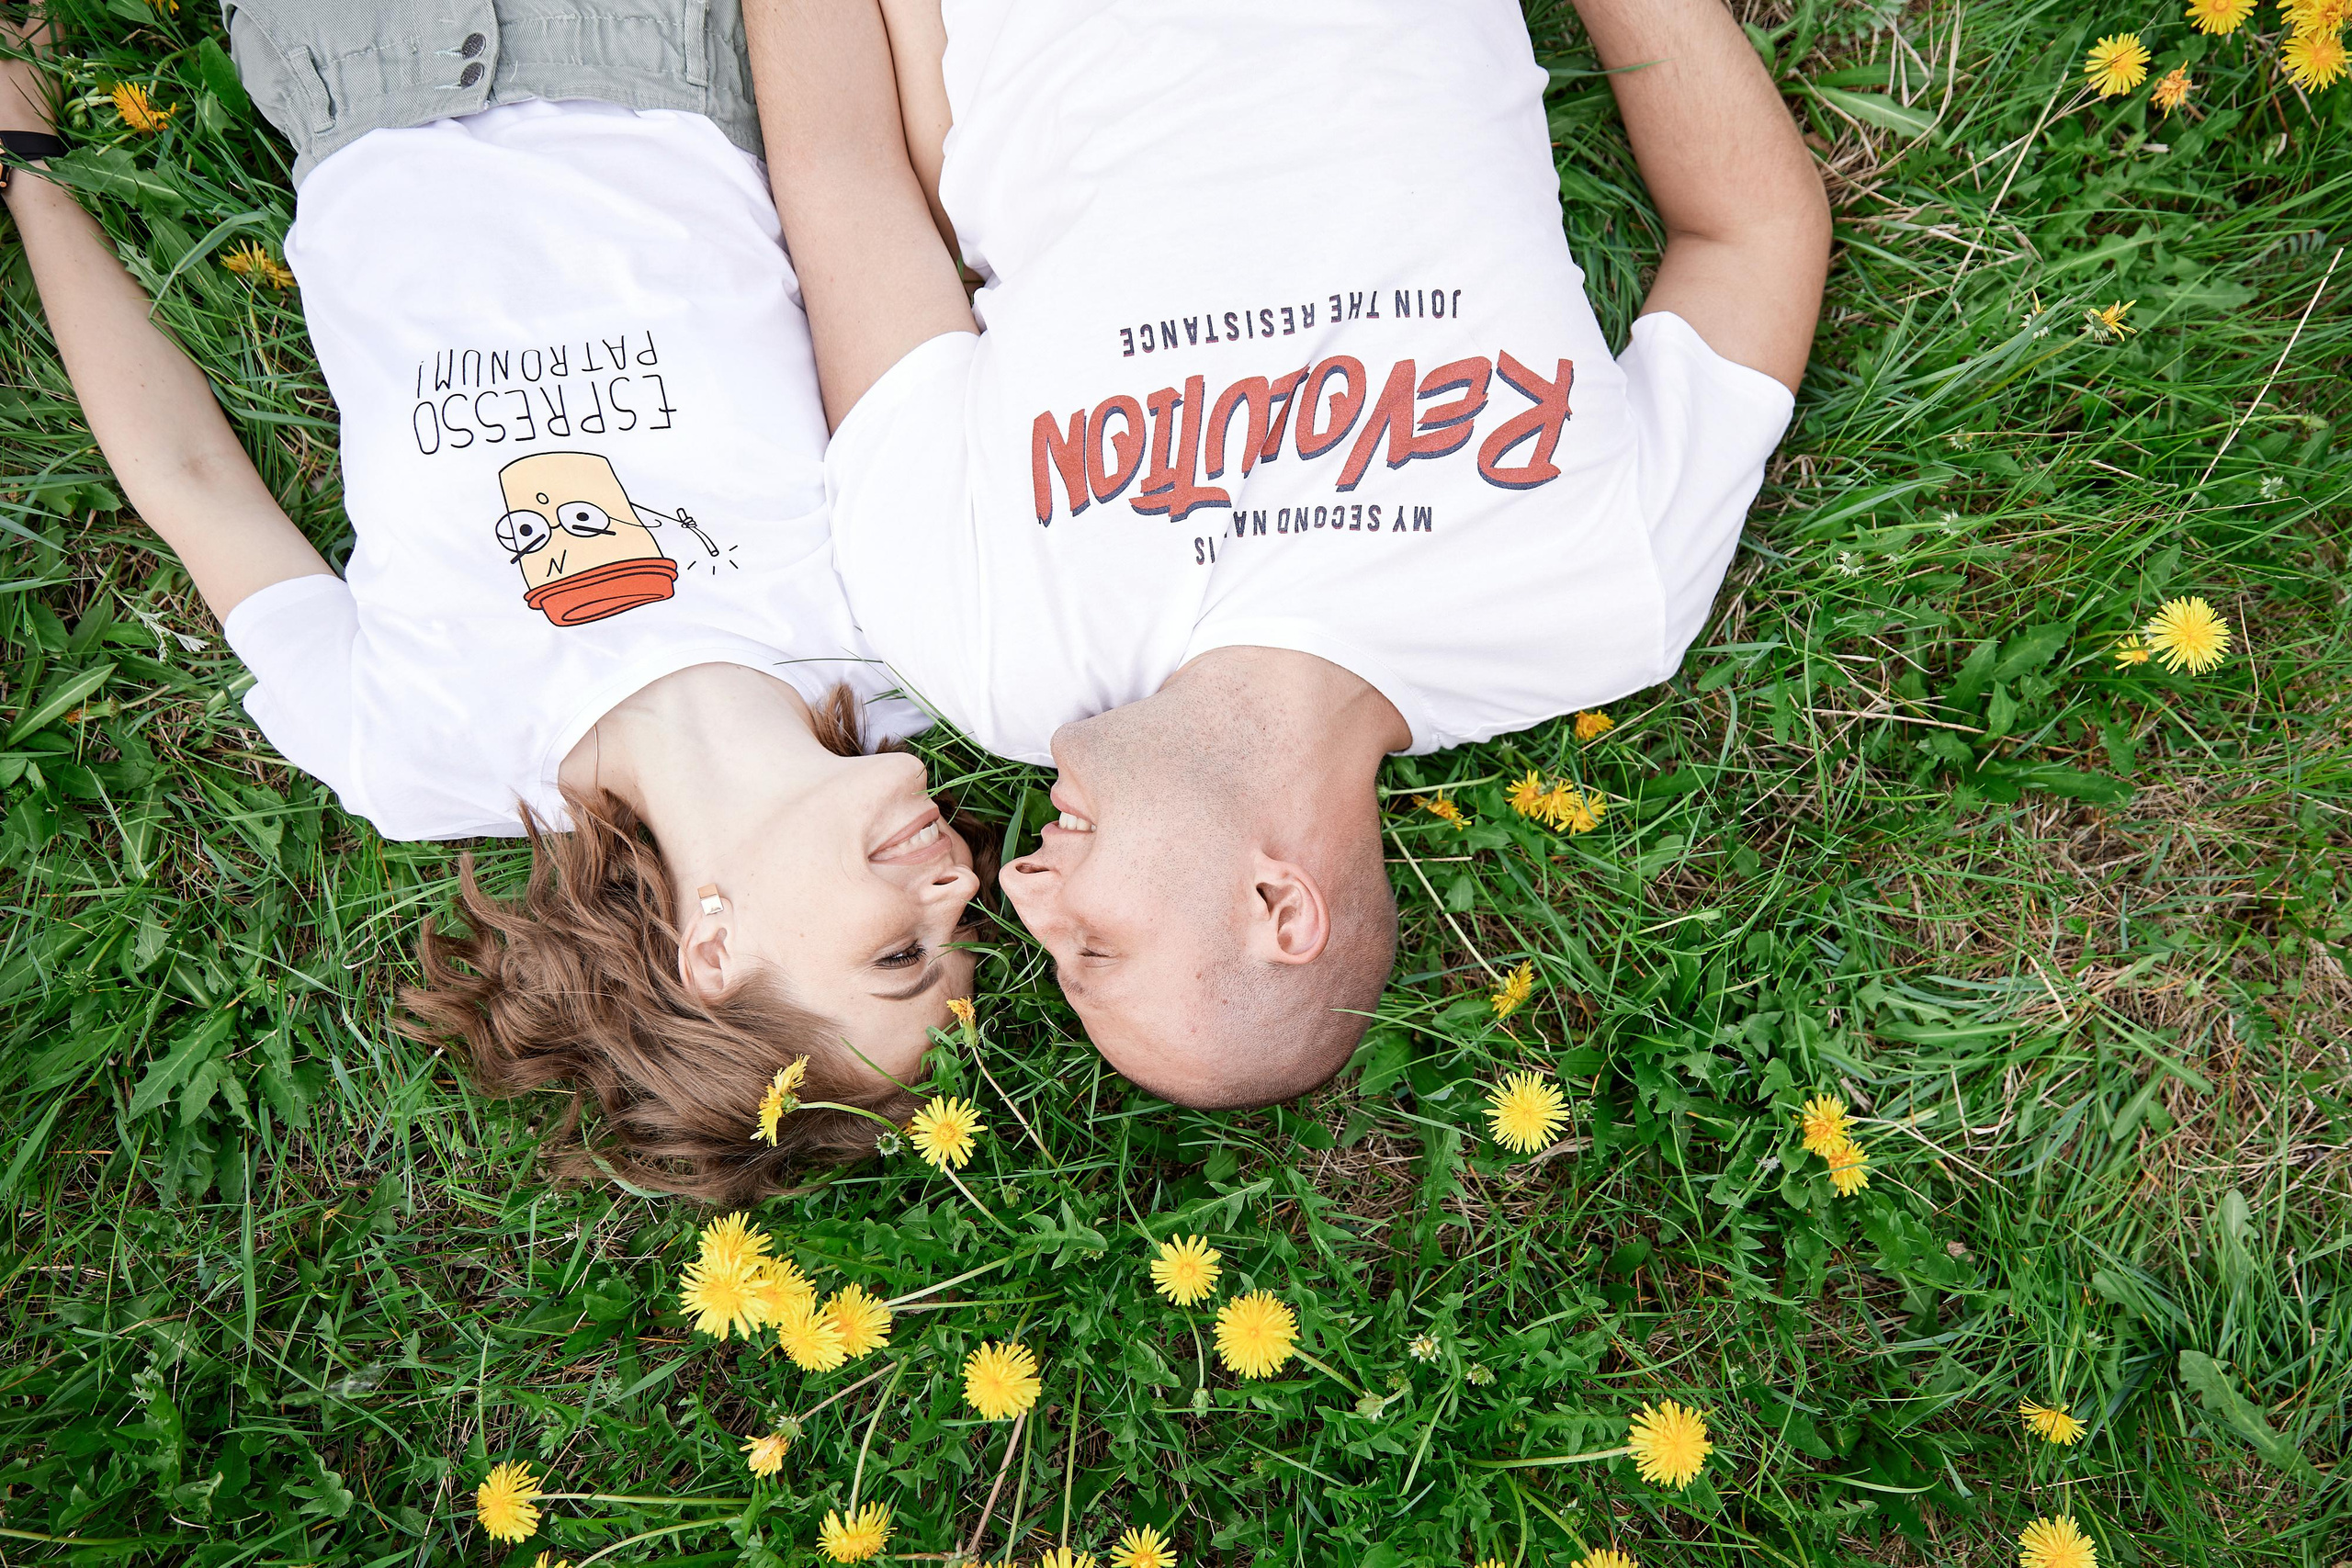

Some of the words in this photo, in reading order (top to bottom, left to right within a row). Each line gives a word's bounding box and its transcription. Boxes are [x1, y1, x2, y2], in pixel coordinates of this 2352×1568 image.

[1329, 290, 1380, 323] THE
[1395, 288, 1462, 319] JOIN
[1120, 303, 1316, 357] RESISTANCE
[418, 330, 658, 399] PATRONUM!
[413, 374, 677, 455] ESPRESSO
[1032, 349, 1574, 527] REVOLUTION
[1278, 504, 1380, 534] SECOND
[1393, 506, 1432, 532] MY
[1194, 536, 1216, 565] IS
